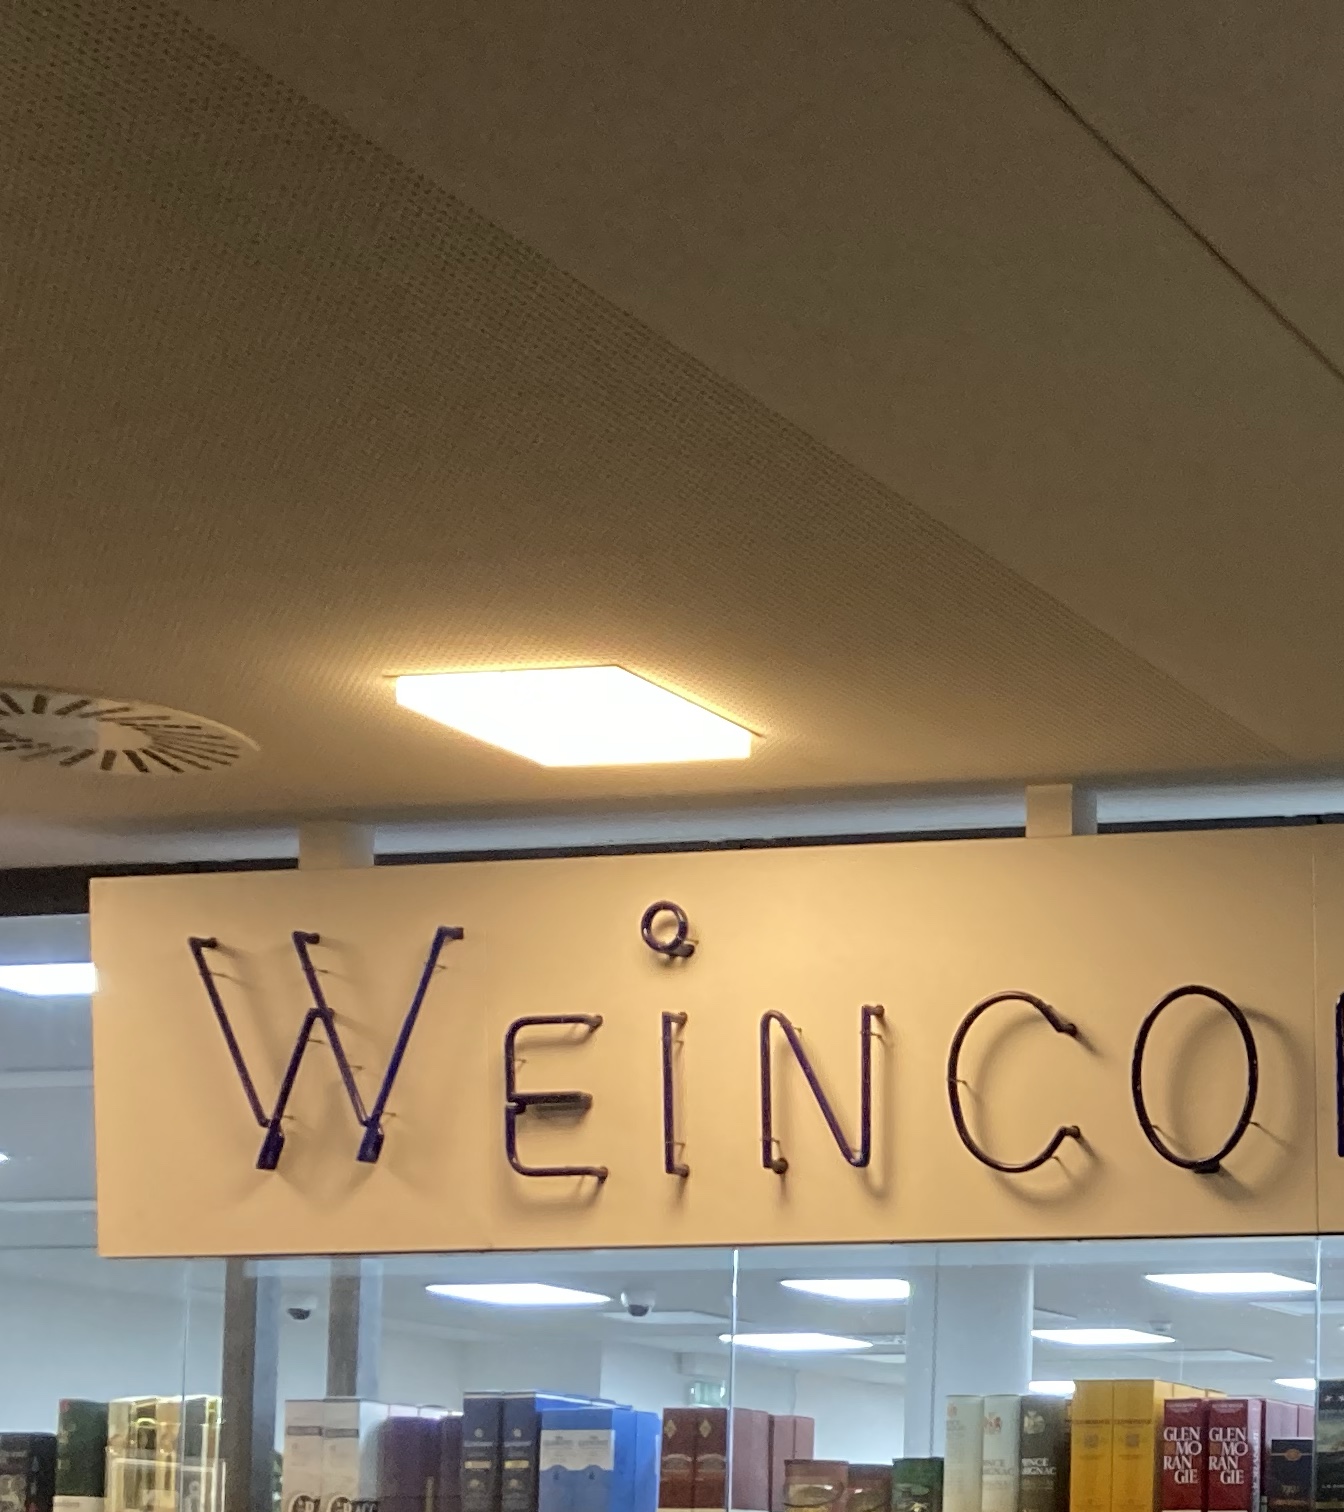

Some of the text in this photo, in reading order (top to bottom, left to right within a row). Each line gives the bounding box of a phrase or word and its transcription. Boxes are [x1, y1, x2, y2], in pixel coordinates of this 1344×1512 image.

[1163, 1426, 1201, 1441] GLEN
[1208, 1426, 1247, 1441] GLEN
[1176, 1441, 1202, 1456] MO
[1221, 1441, 1248, 1456] MO
[1163, 1455, 1191, 1470] RAN
[1208, 1455, 1238, 1470] RAN
[1174, 1469, 1199, 1484] GIE
[1220, 1469, 1244, 1484] GIE
